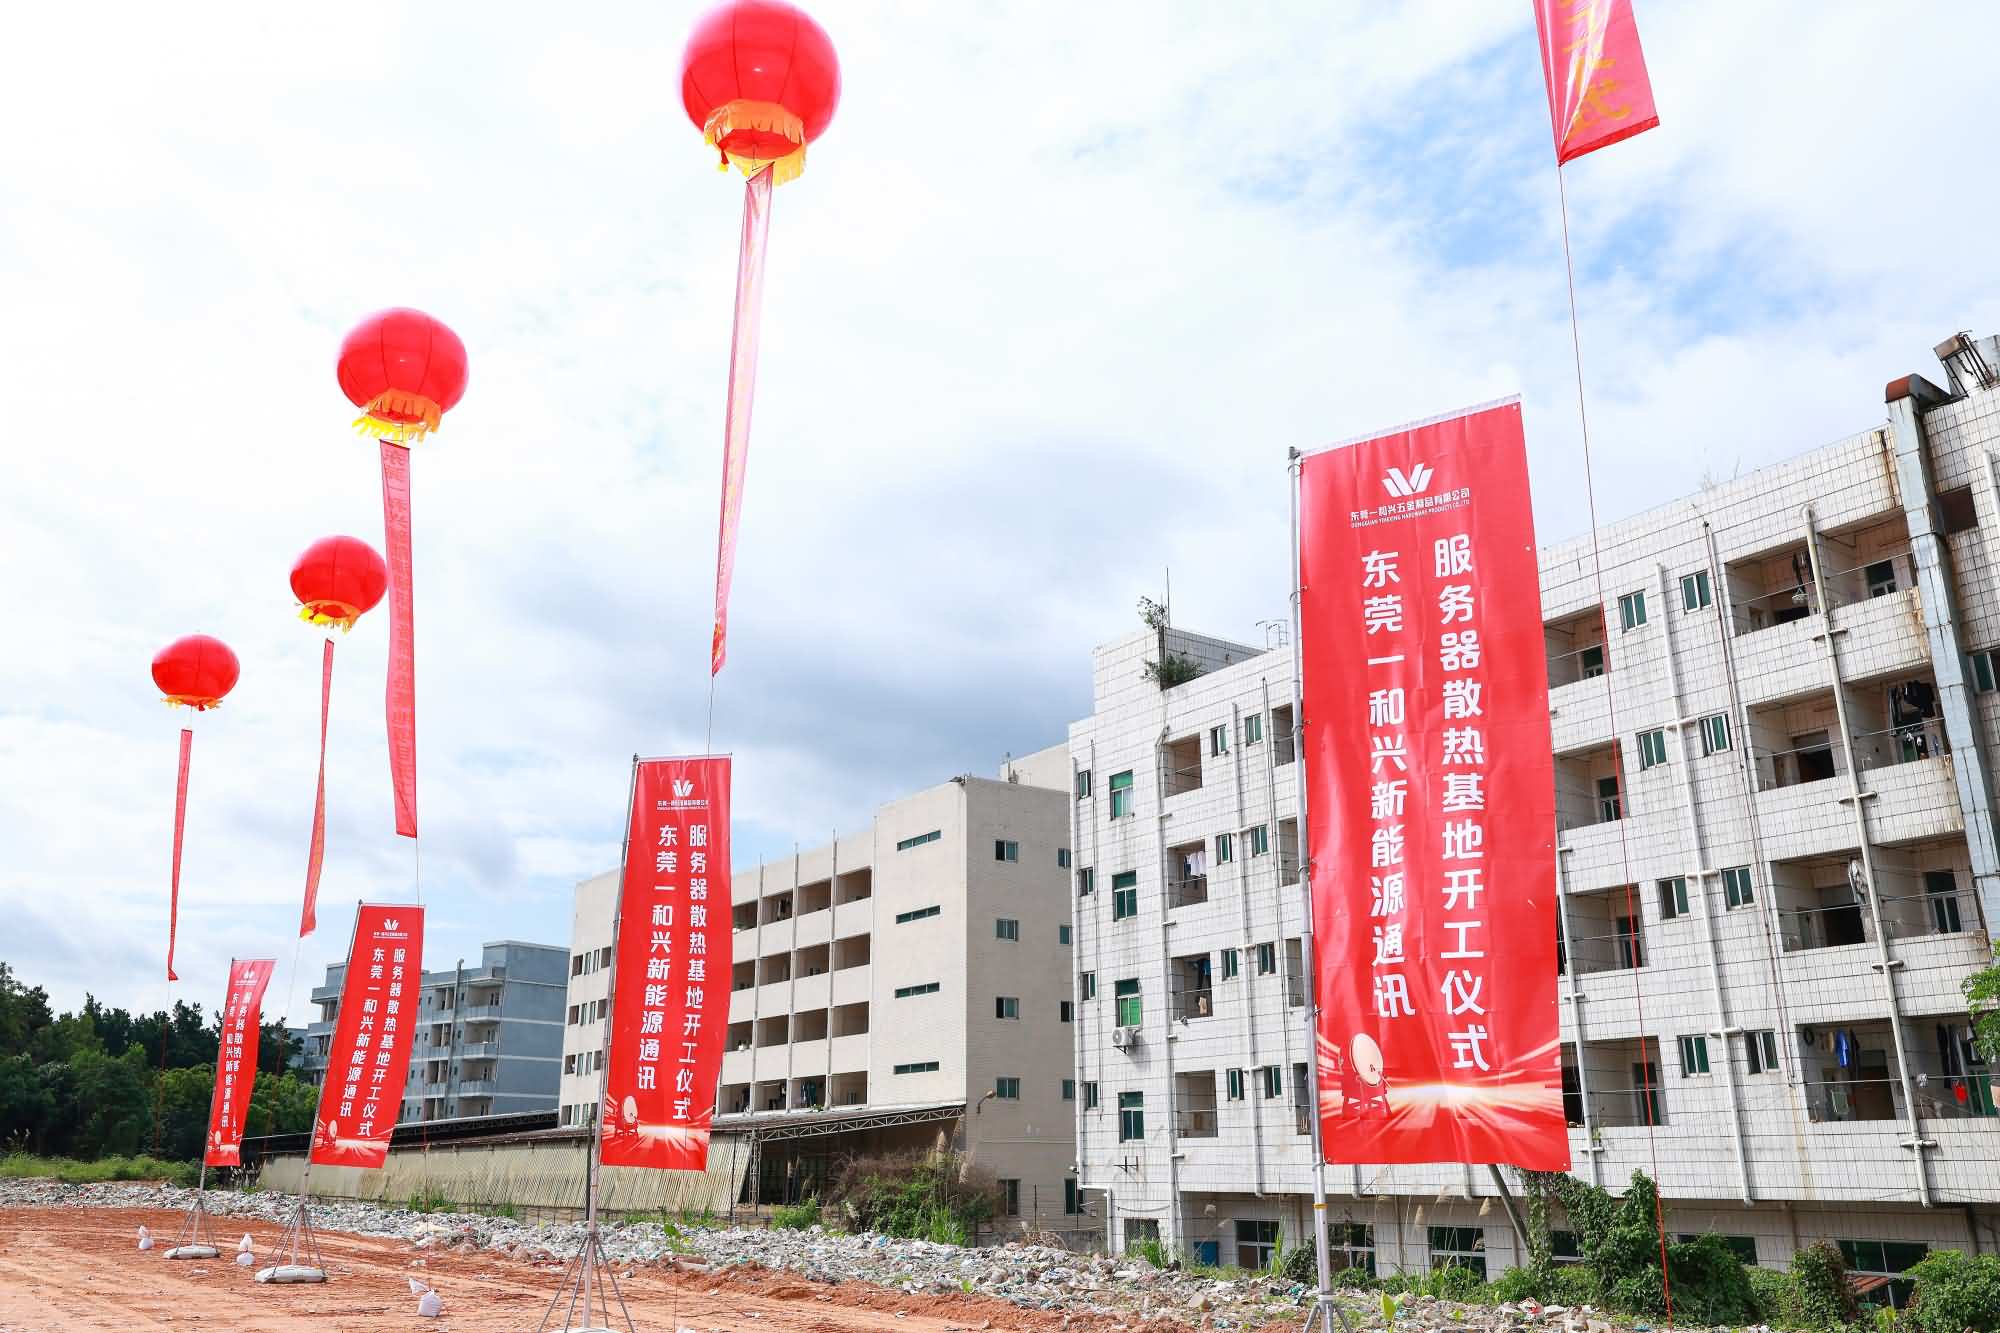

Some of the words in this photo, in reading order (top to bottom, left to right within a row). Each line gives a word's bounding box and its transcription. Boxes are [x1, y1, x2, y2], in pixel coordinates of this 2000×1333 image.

[1361, 550, 1415, 1018] 东莞一和兴新能源通讯
[1434, 533, 1490, 1071] 服务器散热基地开工仪式
[340, 948, 384, 1117] 东莞一和兴新能源通讯
[357, 948, 406, 1137] 服务器散热基地开工仪式
[637, 824, 678, 1090] 东莞一和兴新能源通讯
[672, 824, 707, 1121] 服务器散热基地开工仪式
